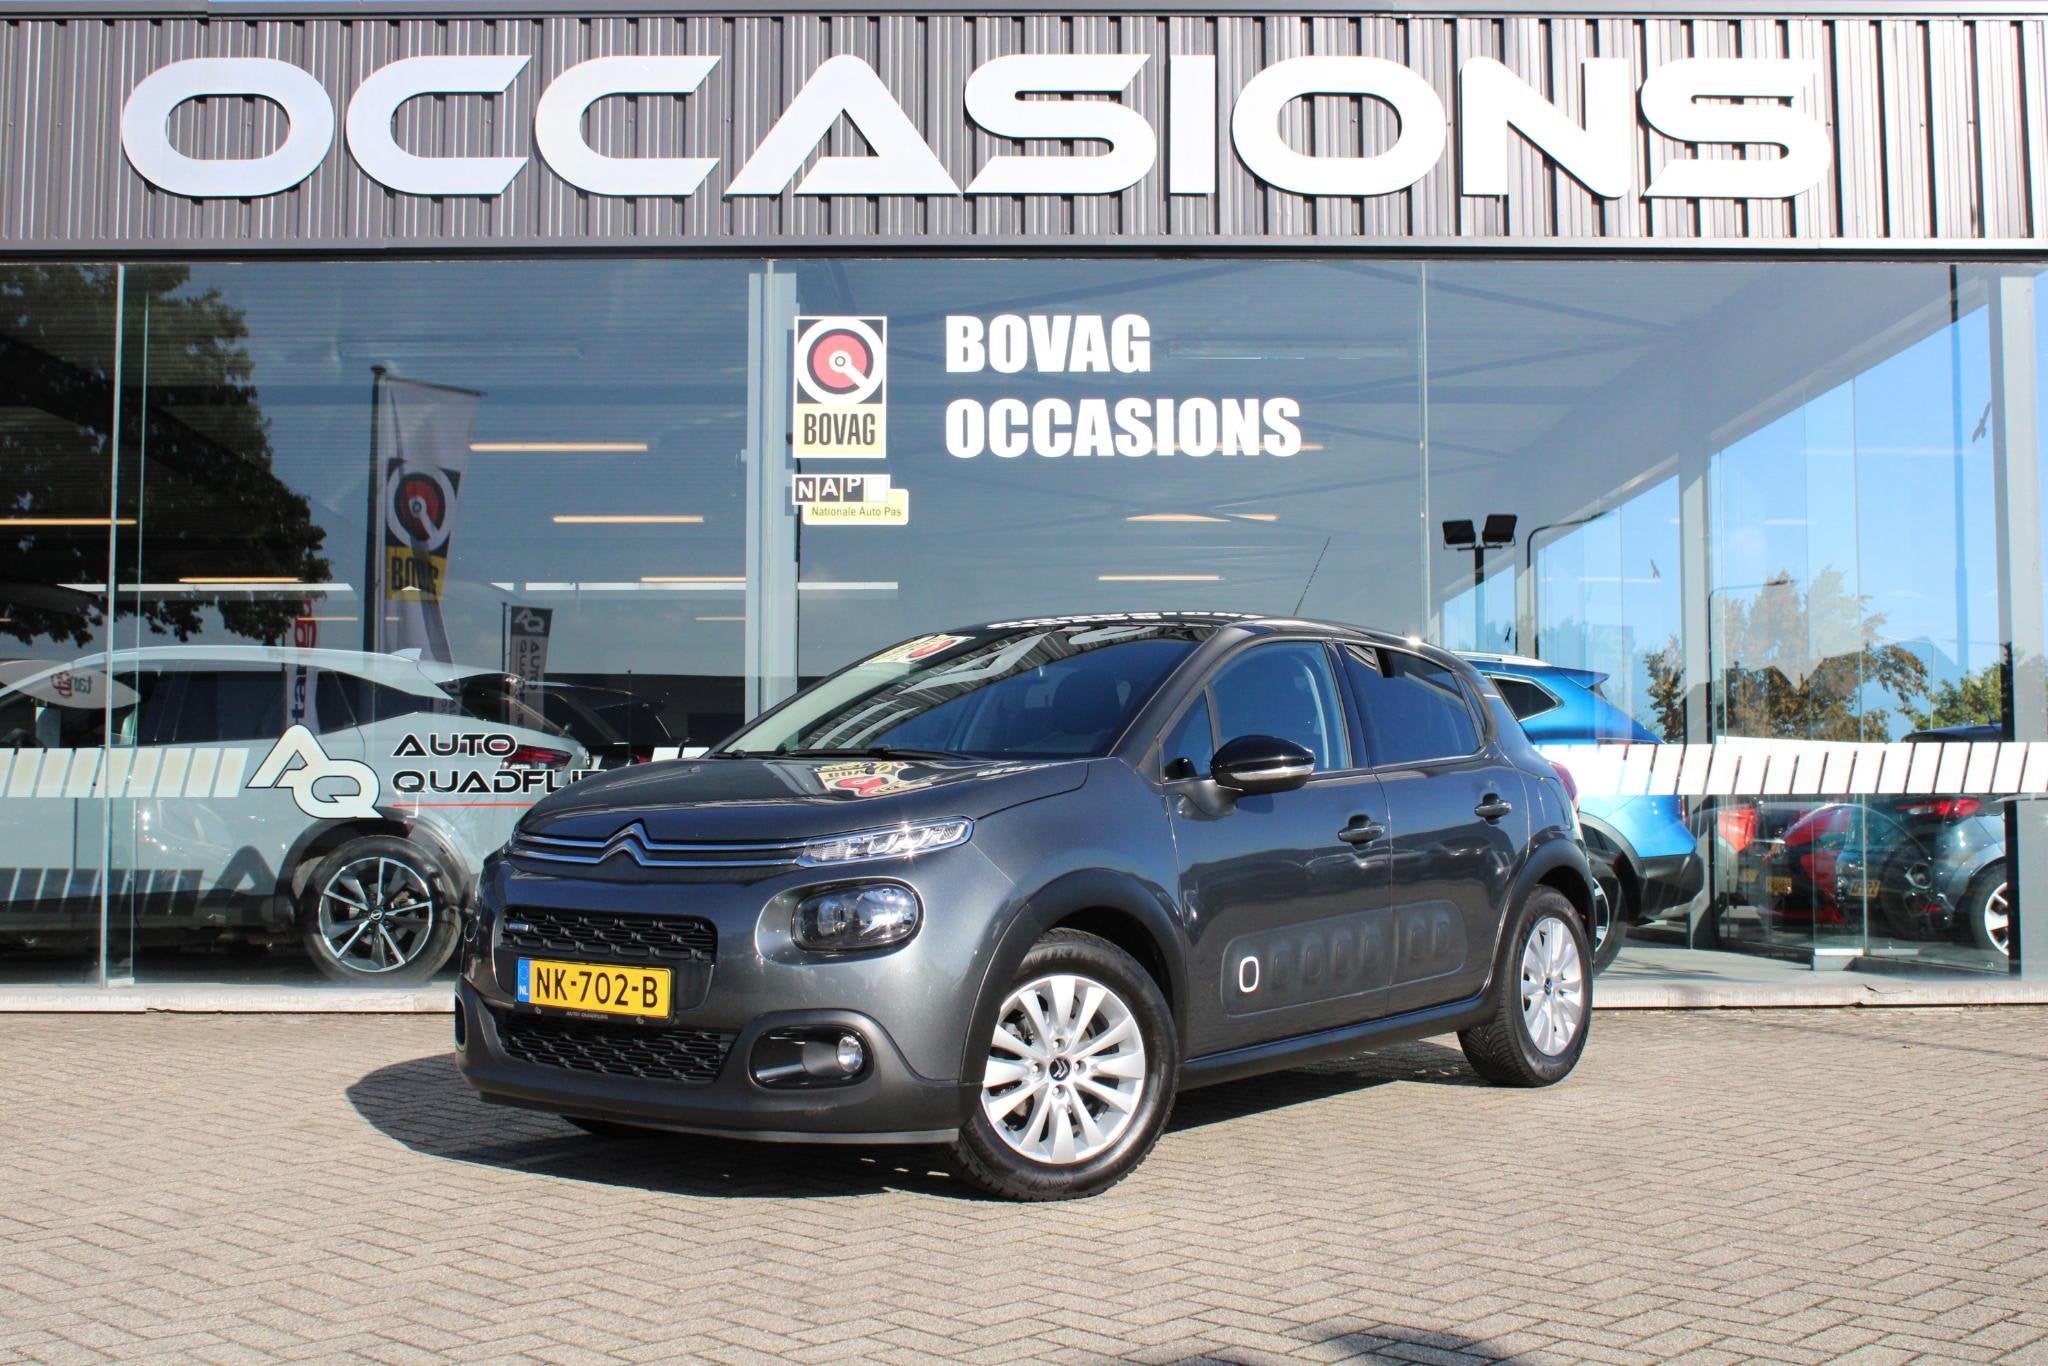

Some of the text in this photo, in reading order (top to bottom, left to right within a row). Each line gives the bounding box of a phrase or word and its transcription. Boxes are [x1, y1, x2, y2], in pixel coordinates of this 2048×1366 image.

[121, 53, 1832, 199] OCCASIONS
[946, 314, 1151, 374] BOVAG
[803, 412, 876, 446] BOVAG
[945, 397, 1302, 458] OCCASIONS
[797, 476, 863, 500] NAP
[811, 505, 902, 517] Nationale Auto Pas
[389, 732, 518, 758] AUTO
[245, 724, 384, 819] AQ
[389, 768, 607, 796] QUADFLI
[519, 966, 659, 1009] NL NK-702-B
